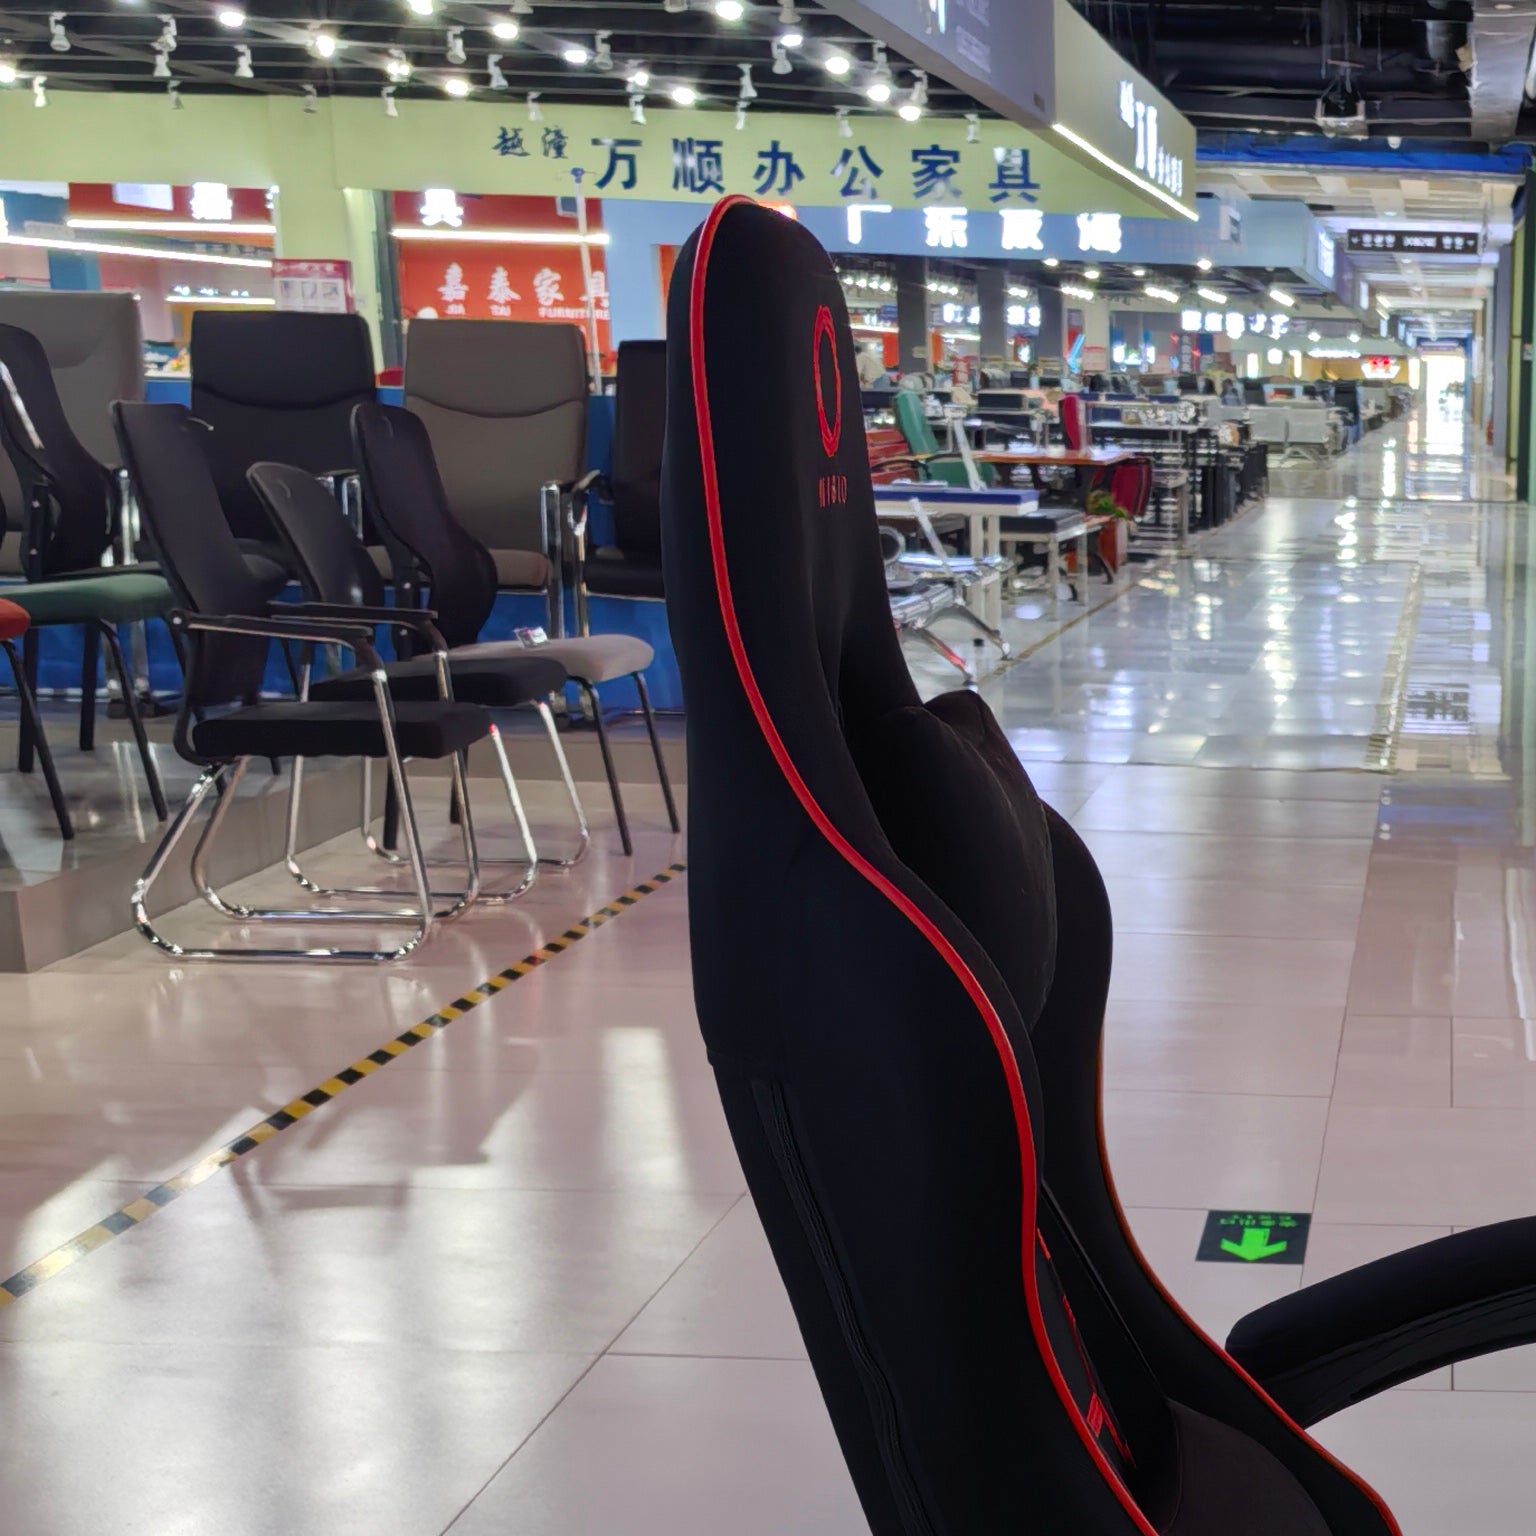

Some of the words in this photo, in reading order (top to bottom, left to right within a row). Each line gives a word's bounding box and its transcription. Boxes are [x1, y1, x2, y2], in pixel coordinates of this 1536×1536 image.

[591, 137, 1041, 204] 万顺办公家具
